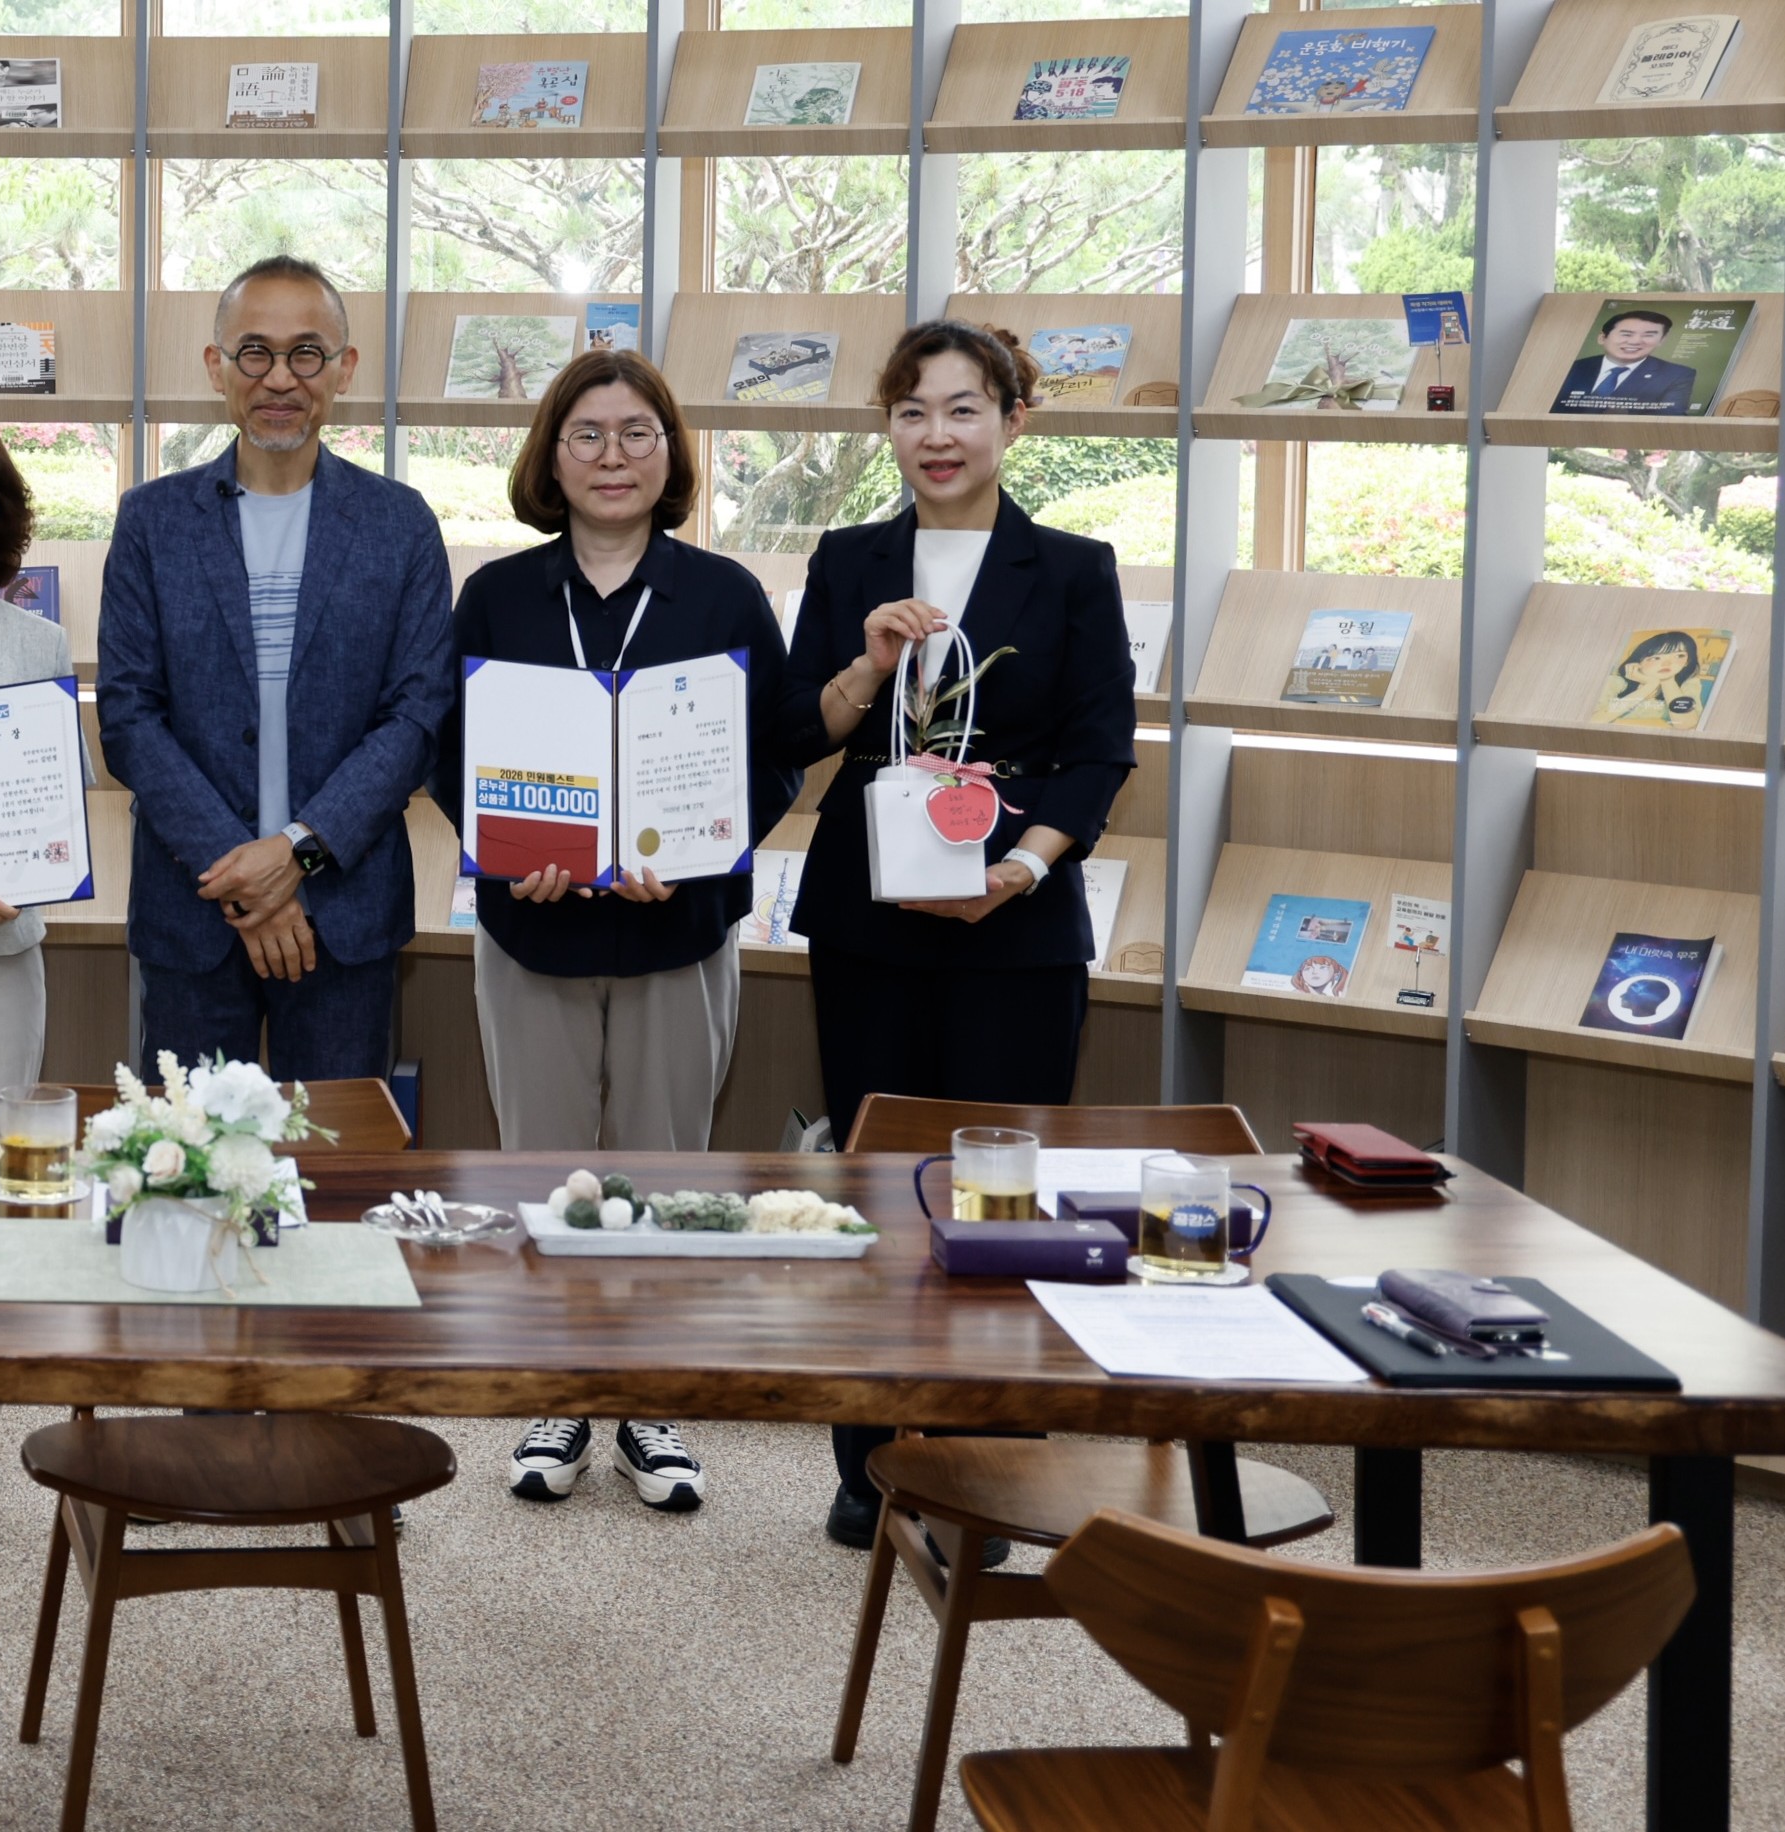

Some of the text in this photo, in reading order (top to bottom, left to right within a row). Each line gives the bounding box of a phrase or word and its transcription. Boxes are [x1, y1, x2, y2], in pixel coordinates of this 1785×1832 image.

[1299, 37, 1407, 56] 운동화 비행기
[1338, 620, 1375, 635] 망월
[500, 769, 575, 785] 2026 민원베스트
[478, 779, 508, 792] 온누리
[478, 792, 508, 806] 상품권
[511, 784, 596, 814] 100,000
[1624, 944, 1637, 954] 내
[1677, 950, 1700, 961] 우주
